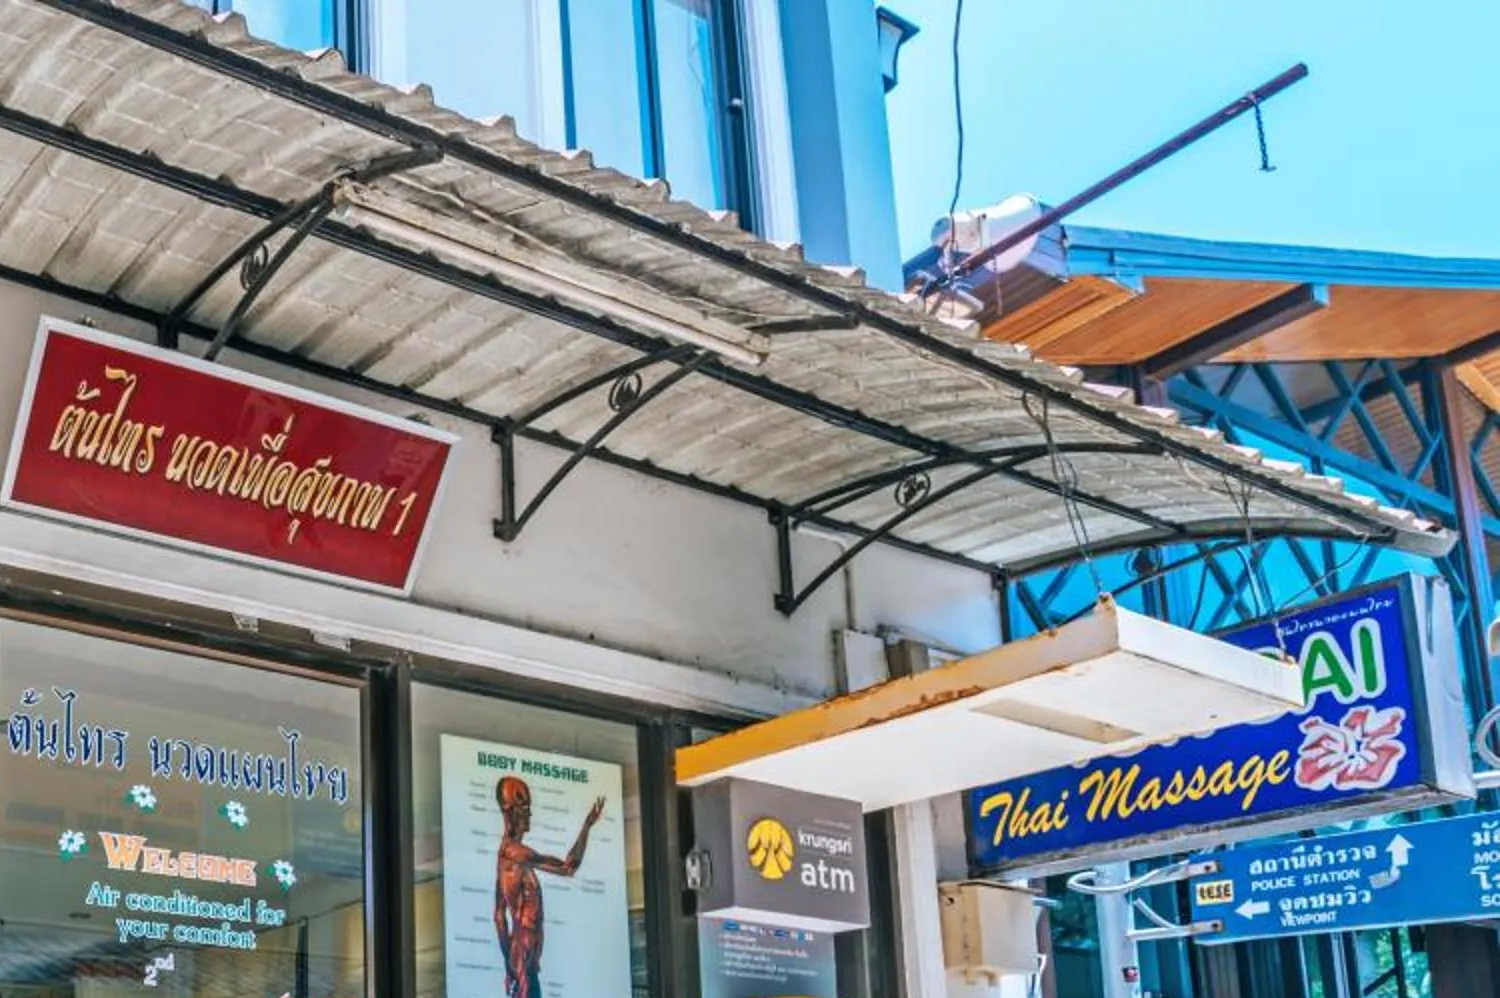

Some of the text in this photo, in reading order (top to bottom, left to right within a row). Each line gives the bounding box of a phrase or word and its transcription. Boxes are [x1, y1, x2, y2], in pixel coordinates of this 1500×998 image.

[50, 365, 165, 474] ต้นไทร
[8, 687, 349, 805] ต้นไทร นวดแผนไทย
[477, 751, 589, 784] BODY MASSAGE
[980, 749, 1290, 847] Thai Massage
[801, 859, 855, 893] atm
[1252, 868, 1361, 892] POLICE STATION
[85, 881, 287, 926] Air conditioned for
[116, 917, 169, 943] your
